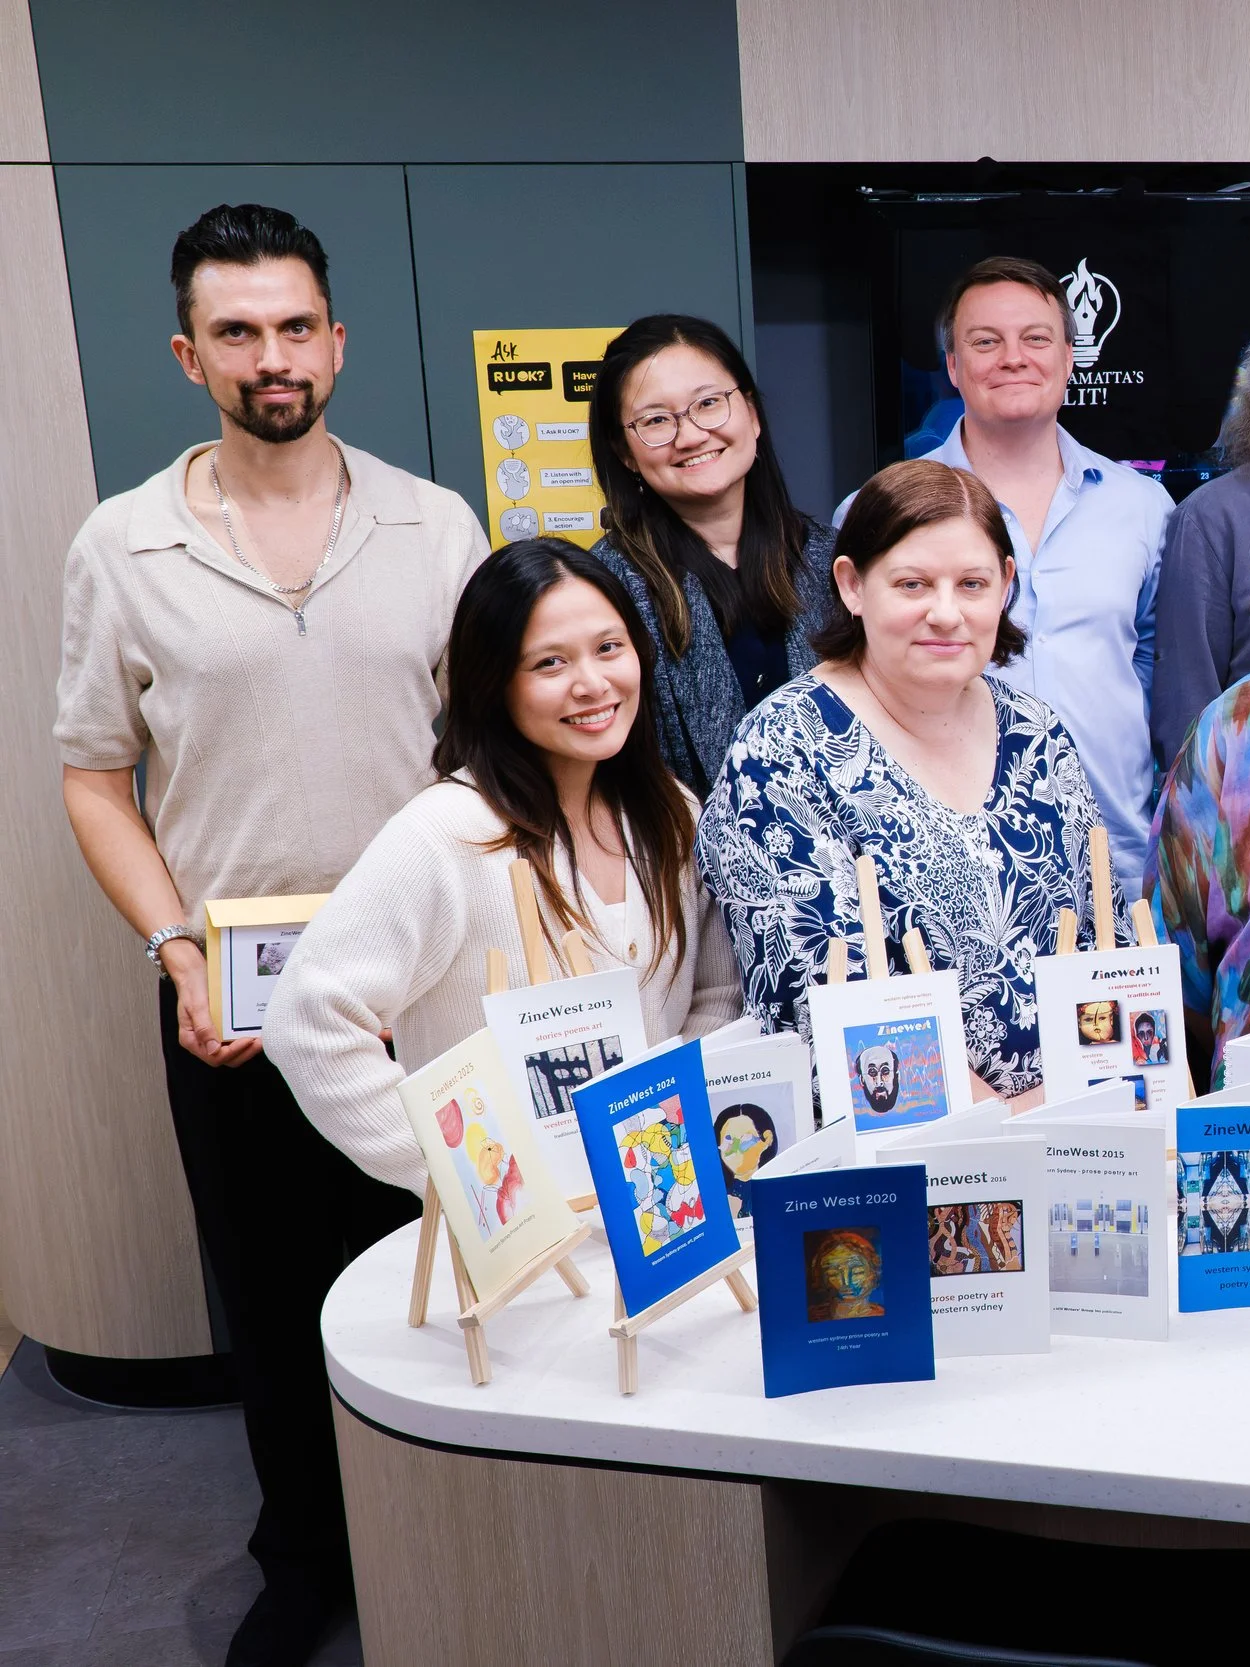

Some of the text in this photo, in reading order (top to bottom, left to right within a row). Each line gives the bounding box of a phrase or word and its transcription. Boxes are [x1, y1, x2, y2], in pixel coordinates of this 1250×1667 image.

[491, 341, 518, 361] Ask
[493, 371, 503, 382] R
[505, 371, 515, 382] U
[573, 372, 597, 380] Have
[1067, 371, 1144, 384] AMATTA'S
[574, 383, 593, 392] usin
[1062, 388, 1107, 406] LIT!
[1148, 966, 1160, 974] 11
[519, 999, 612, 1024] ZineWest 2013
[536, 1032, 562, 1042] stories
[564, 1025, 590, 1037] poems
[430, 1062, 474, 1101] ZineWest 2025
[705, 1071, 771, 1087] ineWest 2014
[608, 1076, 676, 1114] ZineWest 2024
[544, 1119, 572, 1129] western
[1046, 1147, 1124, 1158] ZineWest 2015
[926, 1172, 987, 1187] inewest
[785, 1193, 897, 1213] Zine West 2020
[1204, 1265, 1239, 1275] western
[1220, 1280, 1248, 1290] poetry
[958, 1292, 988, 1301] poetry
[931, 1303, 1004, 1314] western sydney
